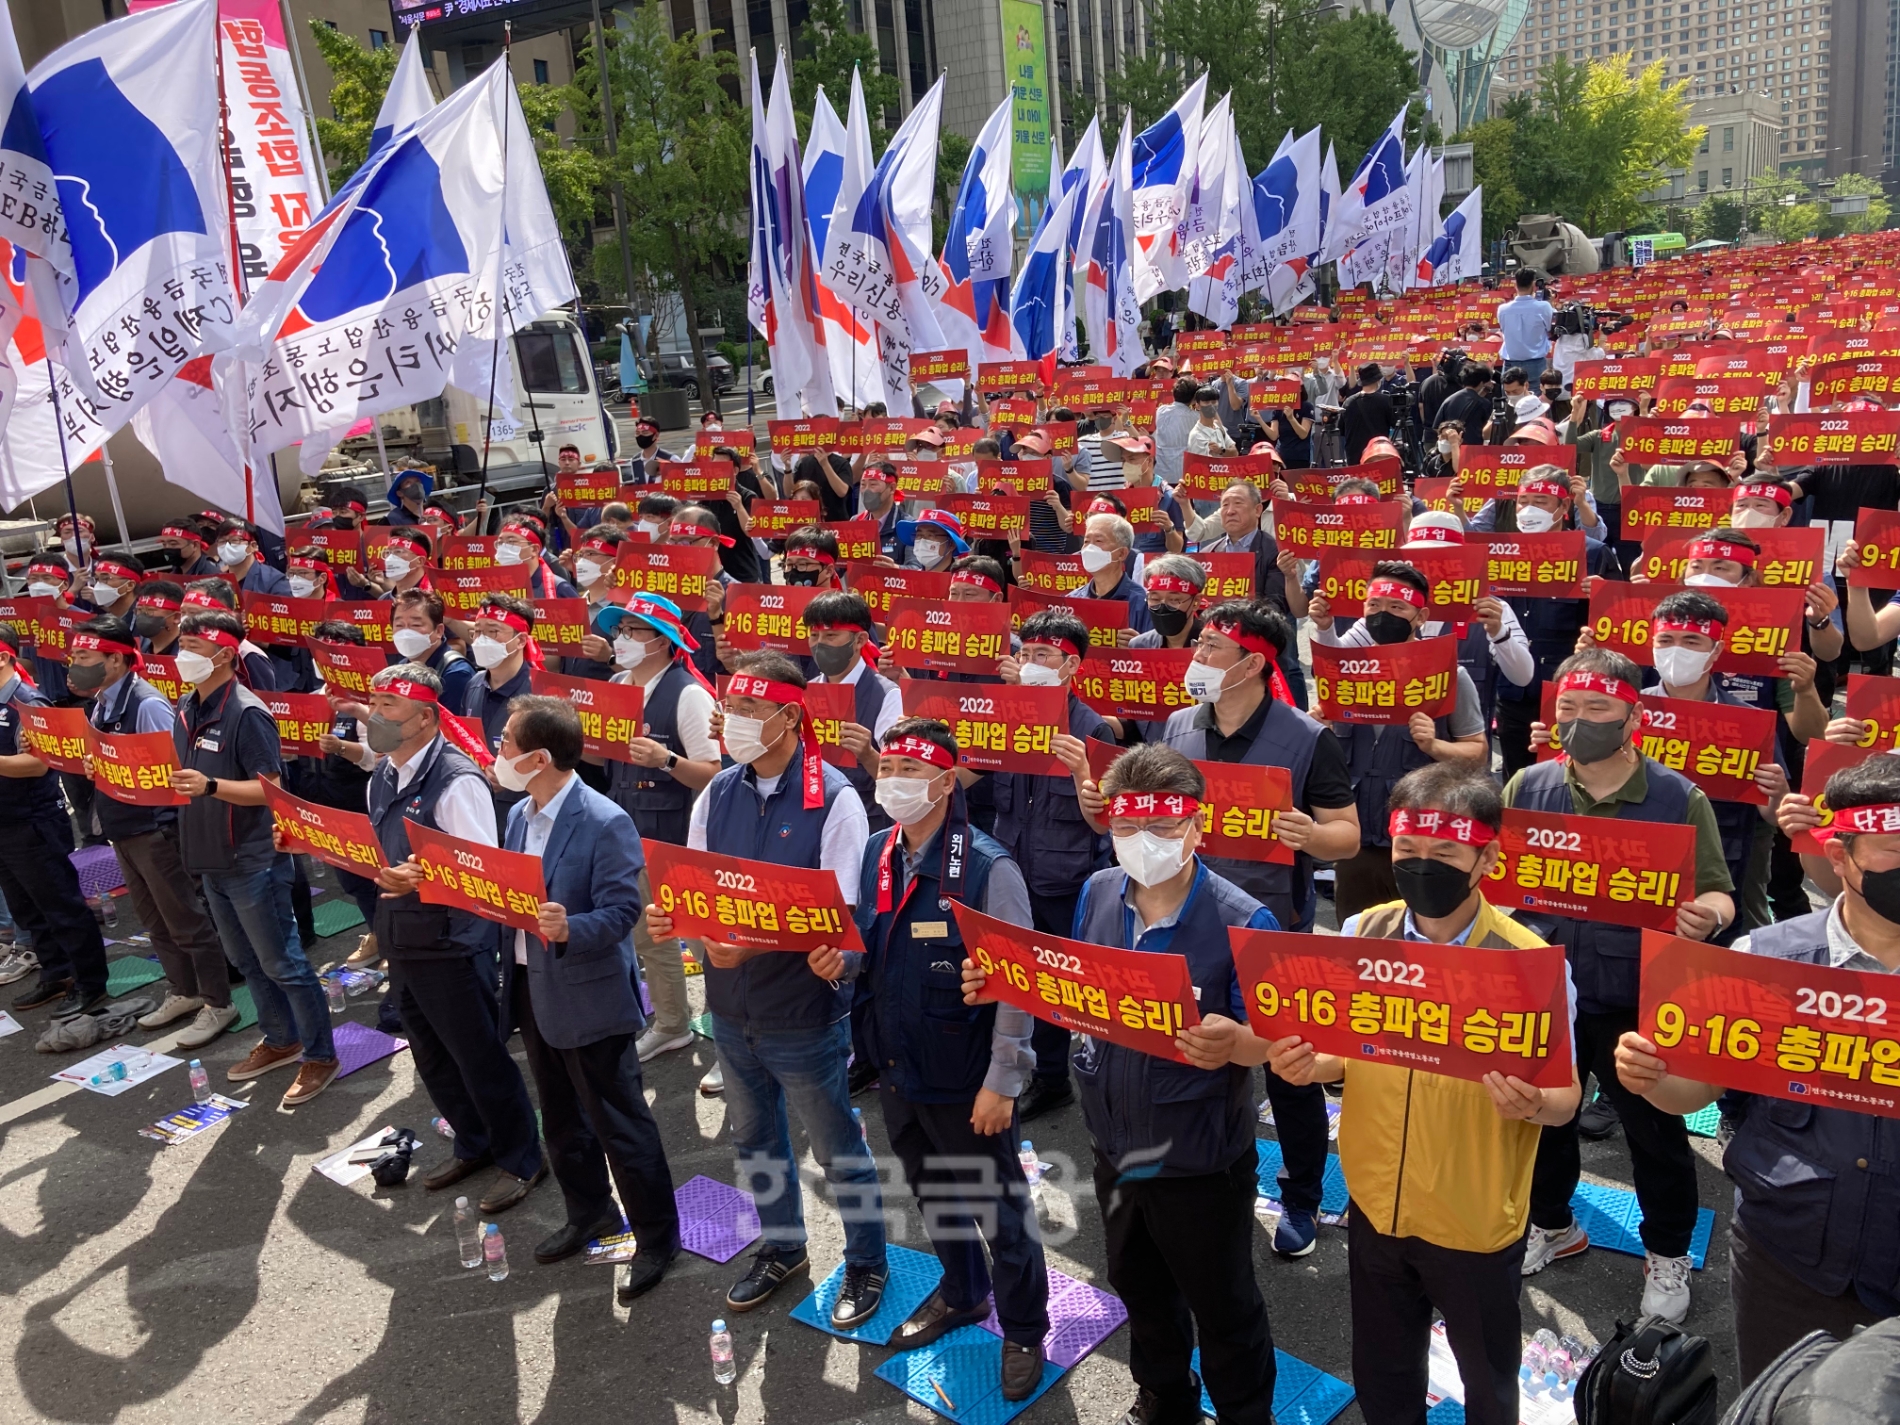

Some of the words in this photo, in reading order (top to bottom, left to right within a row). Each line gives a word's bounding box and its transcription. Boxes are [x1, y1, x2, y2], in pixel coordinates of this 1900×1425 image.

[1028, 87, 1042, 102] 신문
[1031, 131, 1045, 145] 신문
[1603, 365, 1622, 373] 2022
[1857, 363, 1882, 372] 2022
[1598, 376, 1628, 390] 총파업
[1630, 375, 1656, 389] 승리!
[1849, 376, 1889, 392] 총파업
[491, 426, 515, 436] 1365
[1664, 426, 1689, 435] 2022
[1820, 420, 1848, 430] 2022
[793, 434, 815, 446] 총파업
[818, 433, 836, 445] 승리!
[1659, 438, 1697, 454] 총파업
[1701, 439, 1733, 455] 승리!
[1813, 435, 1857, 453] 총파업
[1861, 434, 1897, 452] 승리!
[684, 479, 707, 491] 총파업
[710, 478, 730, 491] 승리!
[973, 501, 990, 510] 2022
[1674, 496, 1704, 507] 2022
[970, 513, 996, 528] 총파업
[1000, 515, 1025, 529] 승리!
[1315, 514, 1343, 524] 2022
[1667, 512, 1713, 528] 총파업
[1312, 529, 1353, 547] 총파업
[1359, 529, 1396, 549] 승리!
[1488, 543, 1519, 555] 2022
[648, 554, 668, 566] 2022
[1488, 560, 1531, 581] 총파업
[1537, 561, 1577, 582] 승리!
[1764, 561, 1813, 584] 승리!
[647, 570, 677, 593] 총파업
[681, 574, 707, 596] 승리!
[1434, 580, 1479, 604] 승리!
[271, 603, 288, 613] 2022
[760, 595, 784, 608] 2022
[272, 617, 297, 634] 총파업
[757, 613, 791, 637] 총파업
[926, 611, 951, 625] 2022
[921, 629, 960, 655] 총파업
[966, 634, 1001, 658] 승리!
[1731, 626, 1789, 656] 승리!
[1340, 660, 1379, 674] 2022
[568, 688, 593, 708] 2022
[1336, 680, 1395, 706] 총파업
[1404, 672, 1449, 706] 승리!
[960, 697, 993, 714] 2022
[606, 717, 636, 744] 승리!
[955, 720, 1006, 750] 총파업
[1014, 725, 1058, 753] 승리!
[99, 742, 117, 760] 2022
[102, 761, 133, 788] 총파업
[137, 764, 174, 789] 승리!
[1110, 791, 1182, 814] 총파업
[297, 804, 327, 825] 2022
[1222, 807, 1280, 840] 승리!
[304, 826, 348, 857] 총파업
[344, 840, 381, 868] 승리!
[1527, 828, 1580, 851] 2022
[454, 850, 484, 871] 2022
[715, 870, 756, 891] 2022
[1517, 854, 1599, 896] 총파업
[1609, 868, 1679, 906] 승리!
[456, 871, 505, 908] 총파업
[503, 888, 541, 919] 승리!
[660, 884, 709, 918] 9·16
[716, 895, 779, 931] 총파업
[786, 906, 842, 933] 승리!
[1033, 946, 1083, 974] 2022
[1358, 958, 1425, 987] 2022
[977, 948, 1029, 991] 9·16
[1036, 972, 1110, 1020] 총파업
[1119, 995, 1182, 1037] 승리!
[1796, 988, 1886, 1024] 2022
[1256, 983, 1336, 1025] 9·16
[1349, 992, 1450, 1044] 총파업
[1463, 1009, 1550, 1057] 승리!
[1654, 1003, 1760, 1059] 9·16
